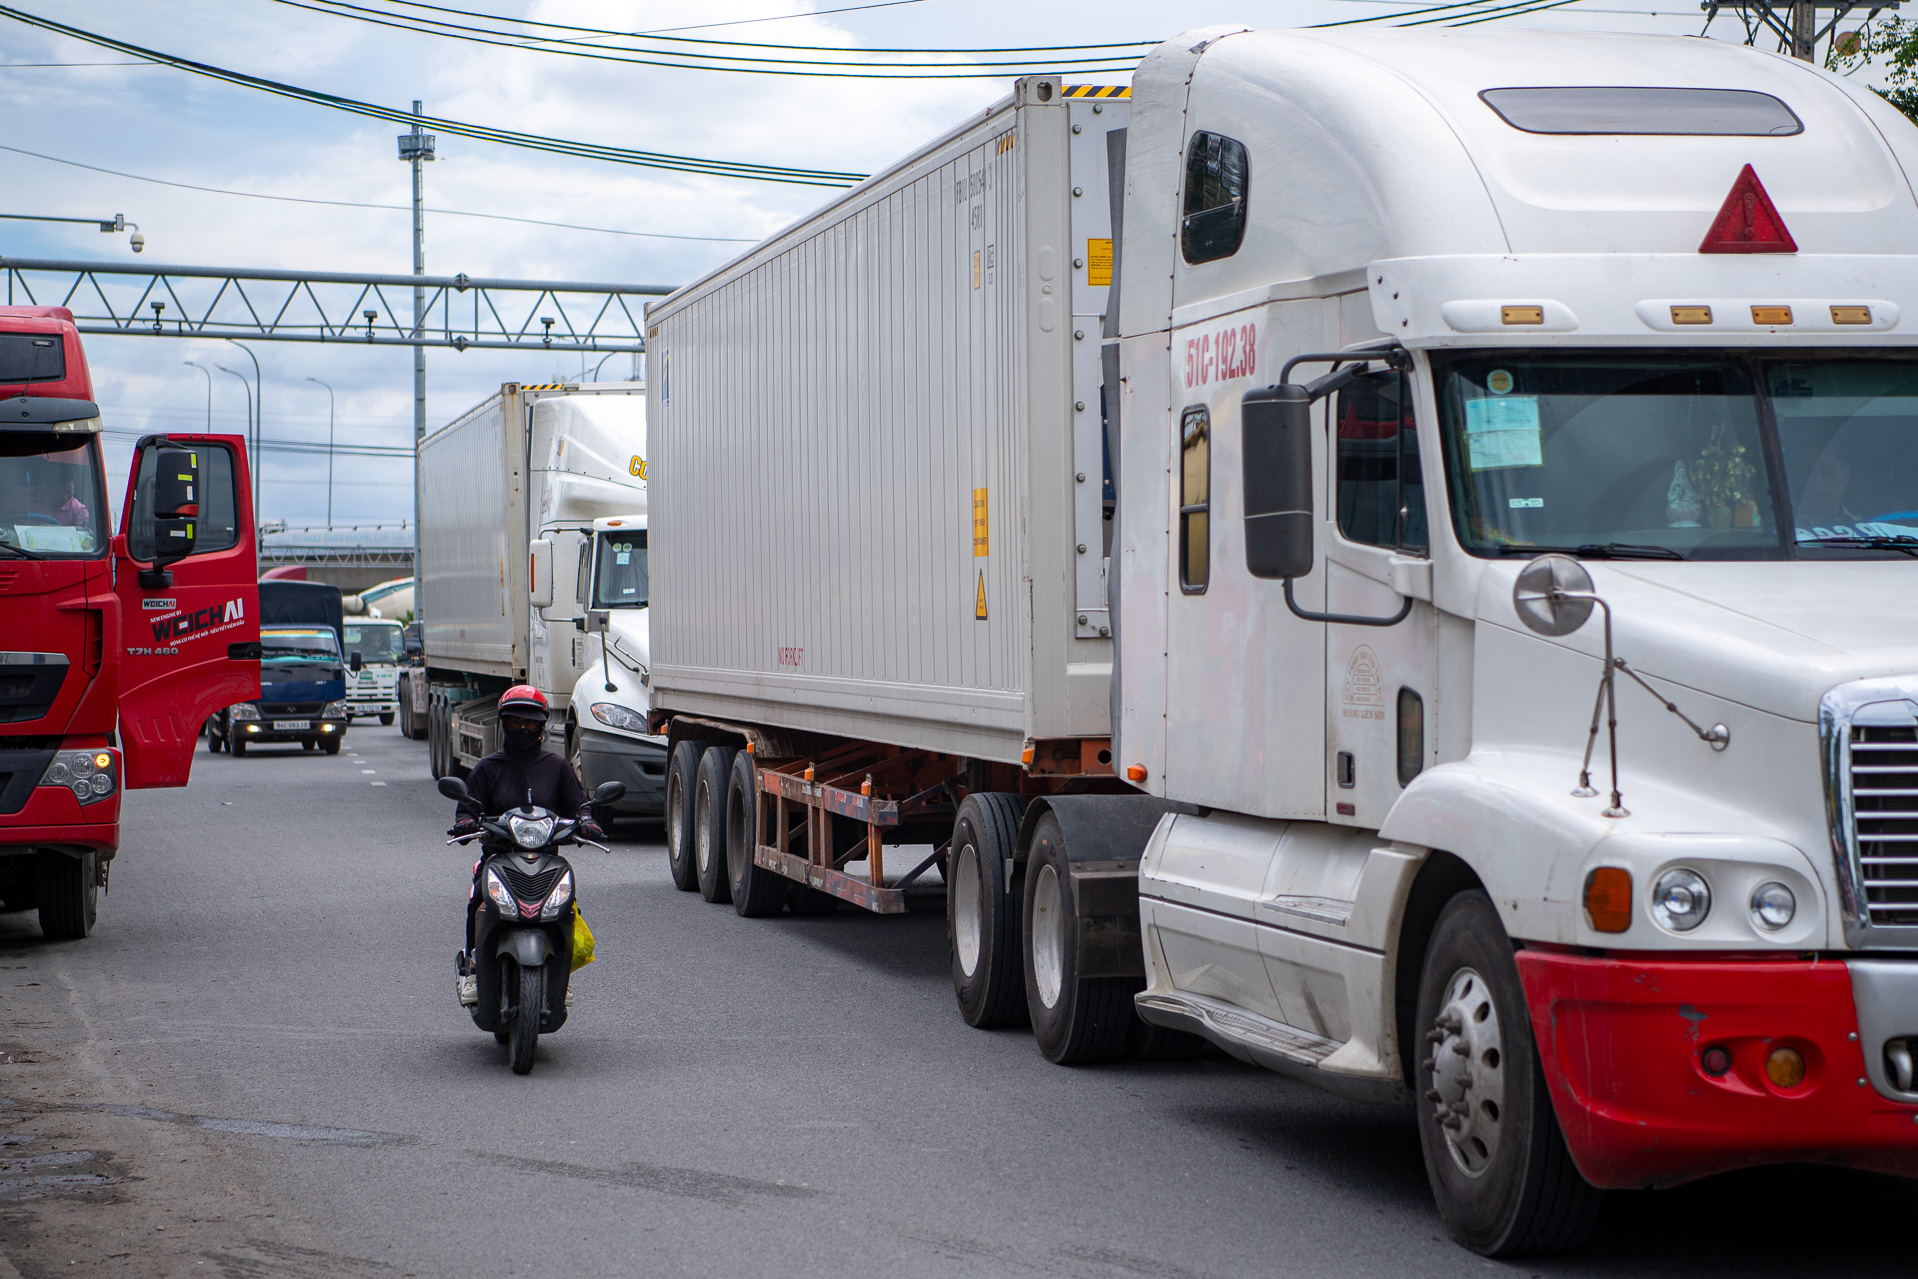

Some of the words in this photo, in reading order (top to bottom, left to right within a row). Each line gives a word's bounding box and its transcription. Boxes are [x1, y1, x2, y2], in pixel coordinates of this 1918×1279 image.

[1186, 323, 1256, 389] 51C-192.38
[143, 600, 176, 608] WEICHAI
[151, 597, 244, 642] WEICHAI
[160, 611, 176, 620] ENGINE
[127, 647, 152, 656] T7H
[154, 647, 179, 656] 460
